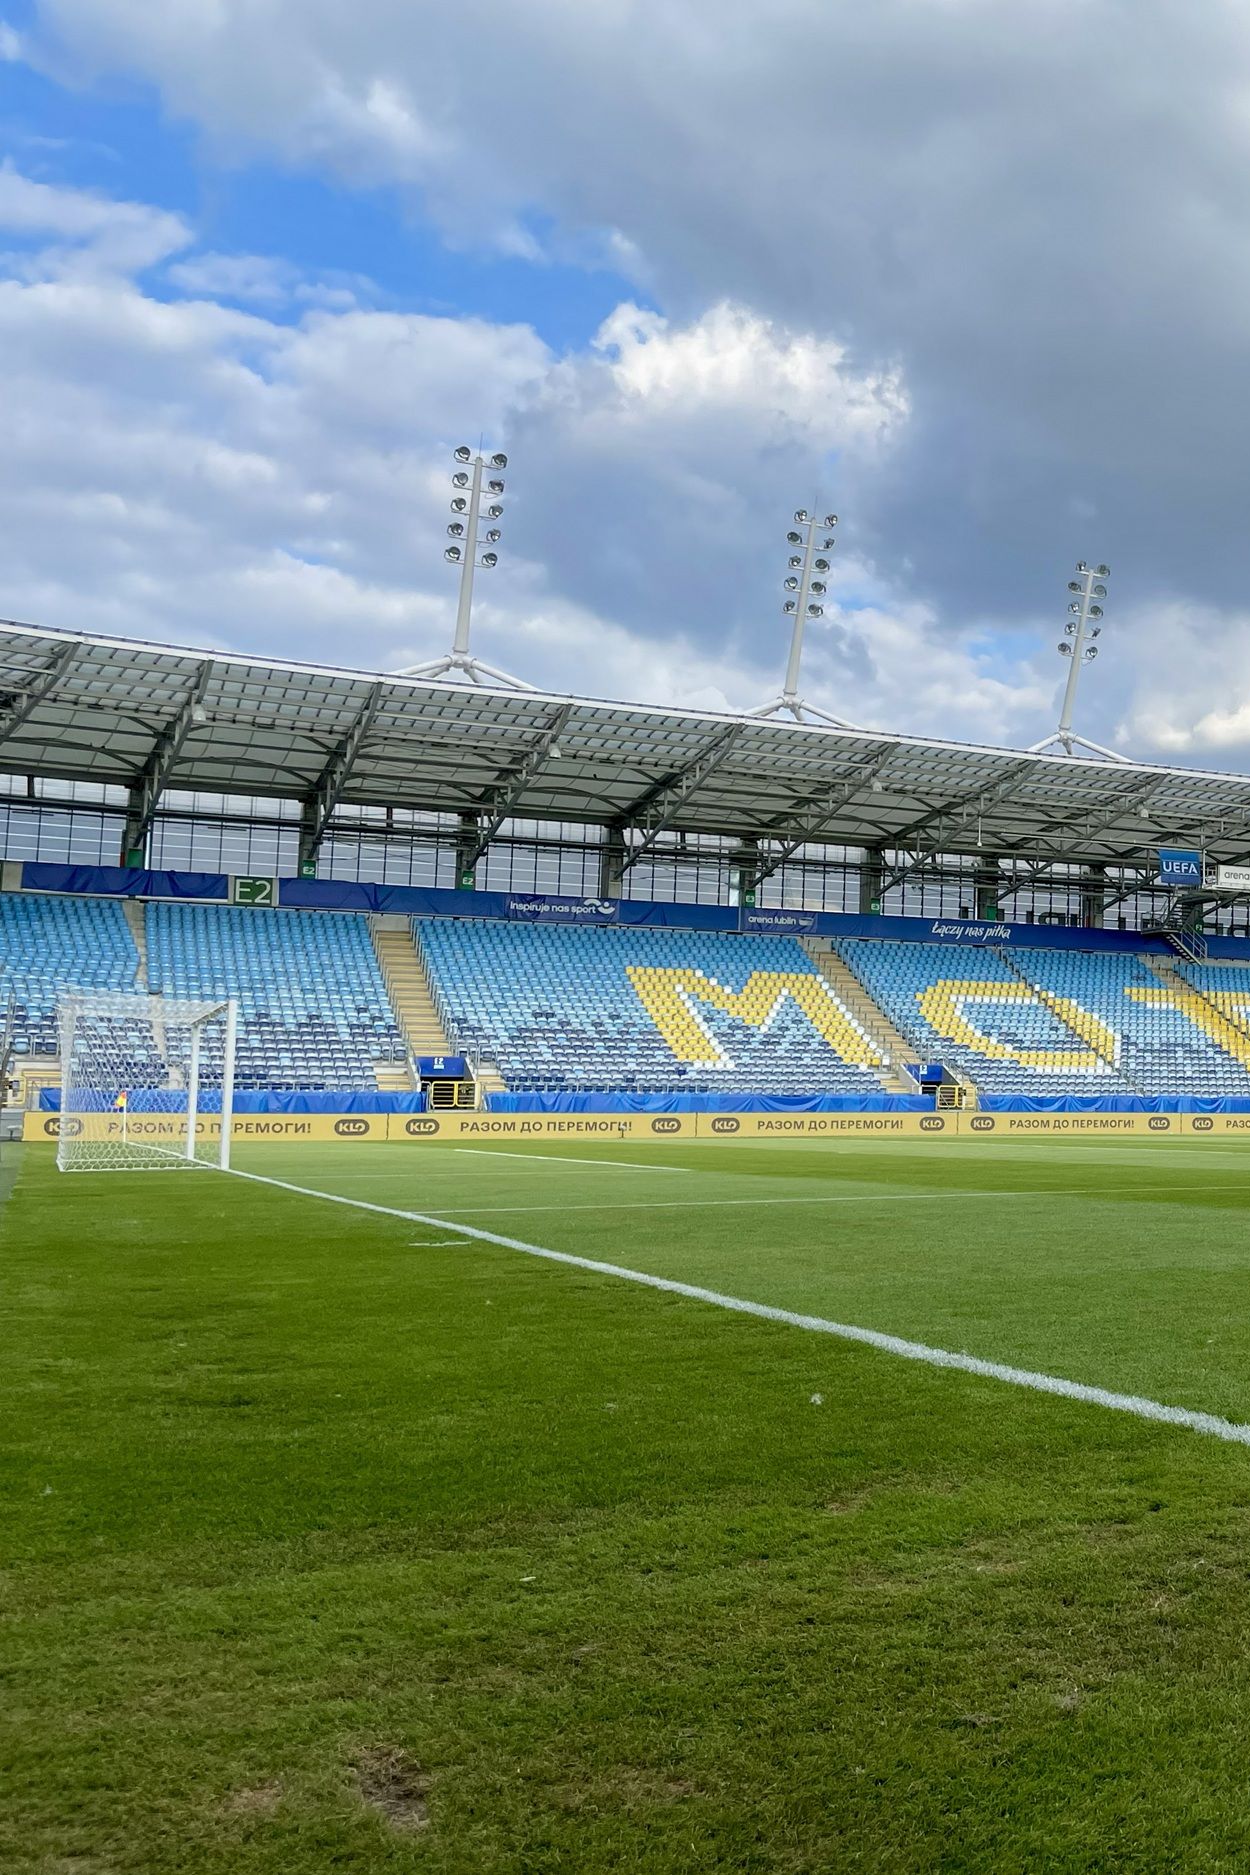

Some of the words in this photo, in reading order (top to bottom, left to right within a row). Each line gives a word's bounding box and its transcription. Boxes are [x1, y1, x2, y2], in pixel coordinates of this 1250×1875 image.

[302, 866, 316, 875] E2
[1162, 860, 1198, 874] UEFA
[462, 876, 474, 885] E2
[1224, 871, 1250, 881] arena
[234, 878, 272, 904] E2
[551, 905, 570, 913] nas
[571, 904, 597, 915] sport
[747, 916, 774, 925] arena
[774, 916, 797, 926] lublin
[931, 921, 962, 940] Łączy
[964, 926, 984, 938] nas
[982, 925, 1012, 942] piłka
[46, 1120, 81, 1134] KO
[108, 1122, 174, 1134] РАЗОМ
[210, 1122, 311, 1134] ПРЕМОГИ!
[459, 1121, 517, 1132] РАЗОМ
[520, 1121, 543, 1133] ДО
[757, 1120, 805, 1131] РАЗОМ
[808, 1120, 828, 1132] ДО
[830, 1119, 904, 1130] ПЕРЕМОГИ!
[1009, 1119, 1050, 1129] РАЗОМ
[1052, 1119, 1069, 1130] ДО
[1071, 1119, 1135, 1129] ПЕРЕМОГИ!
